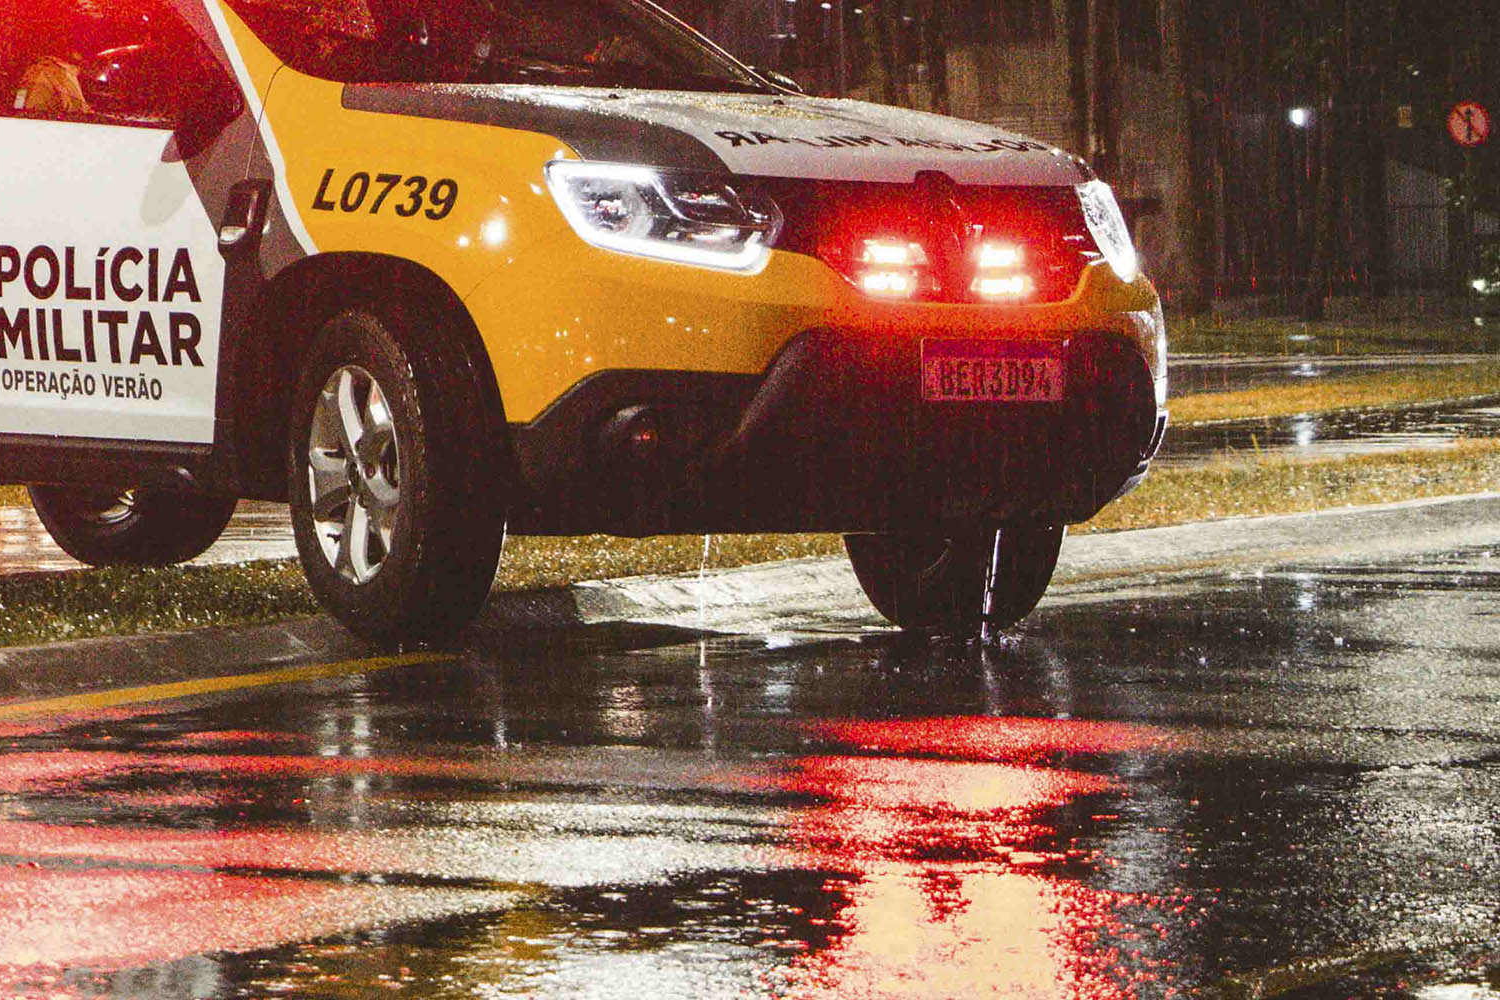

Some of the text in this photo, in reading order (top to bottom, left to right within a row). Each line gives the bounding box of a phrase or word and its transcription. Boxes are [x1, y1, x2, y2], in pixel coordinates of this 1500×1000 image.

[311, 168, 459, 221] L0739
[1, 368, 163, 401] OPERAÇÃO VERÃO
